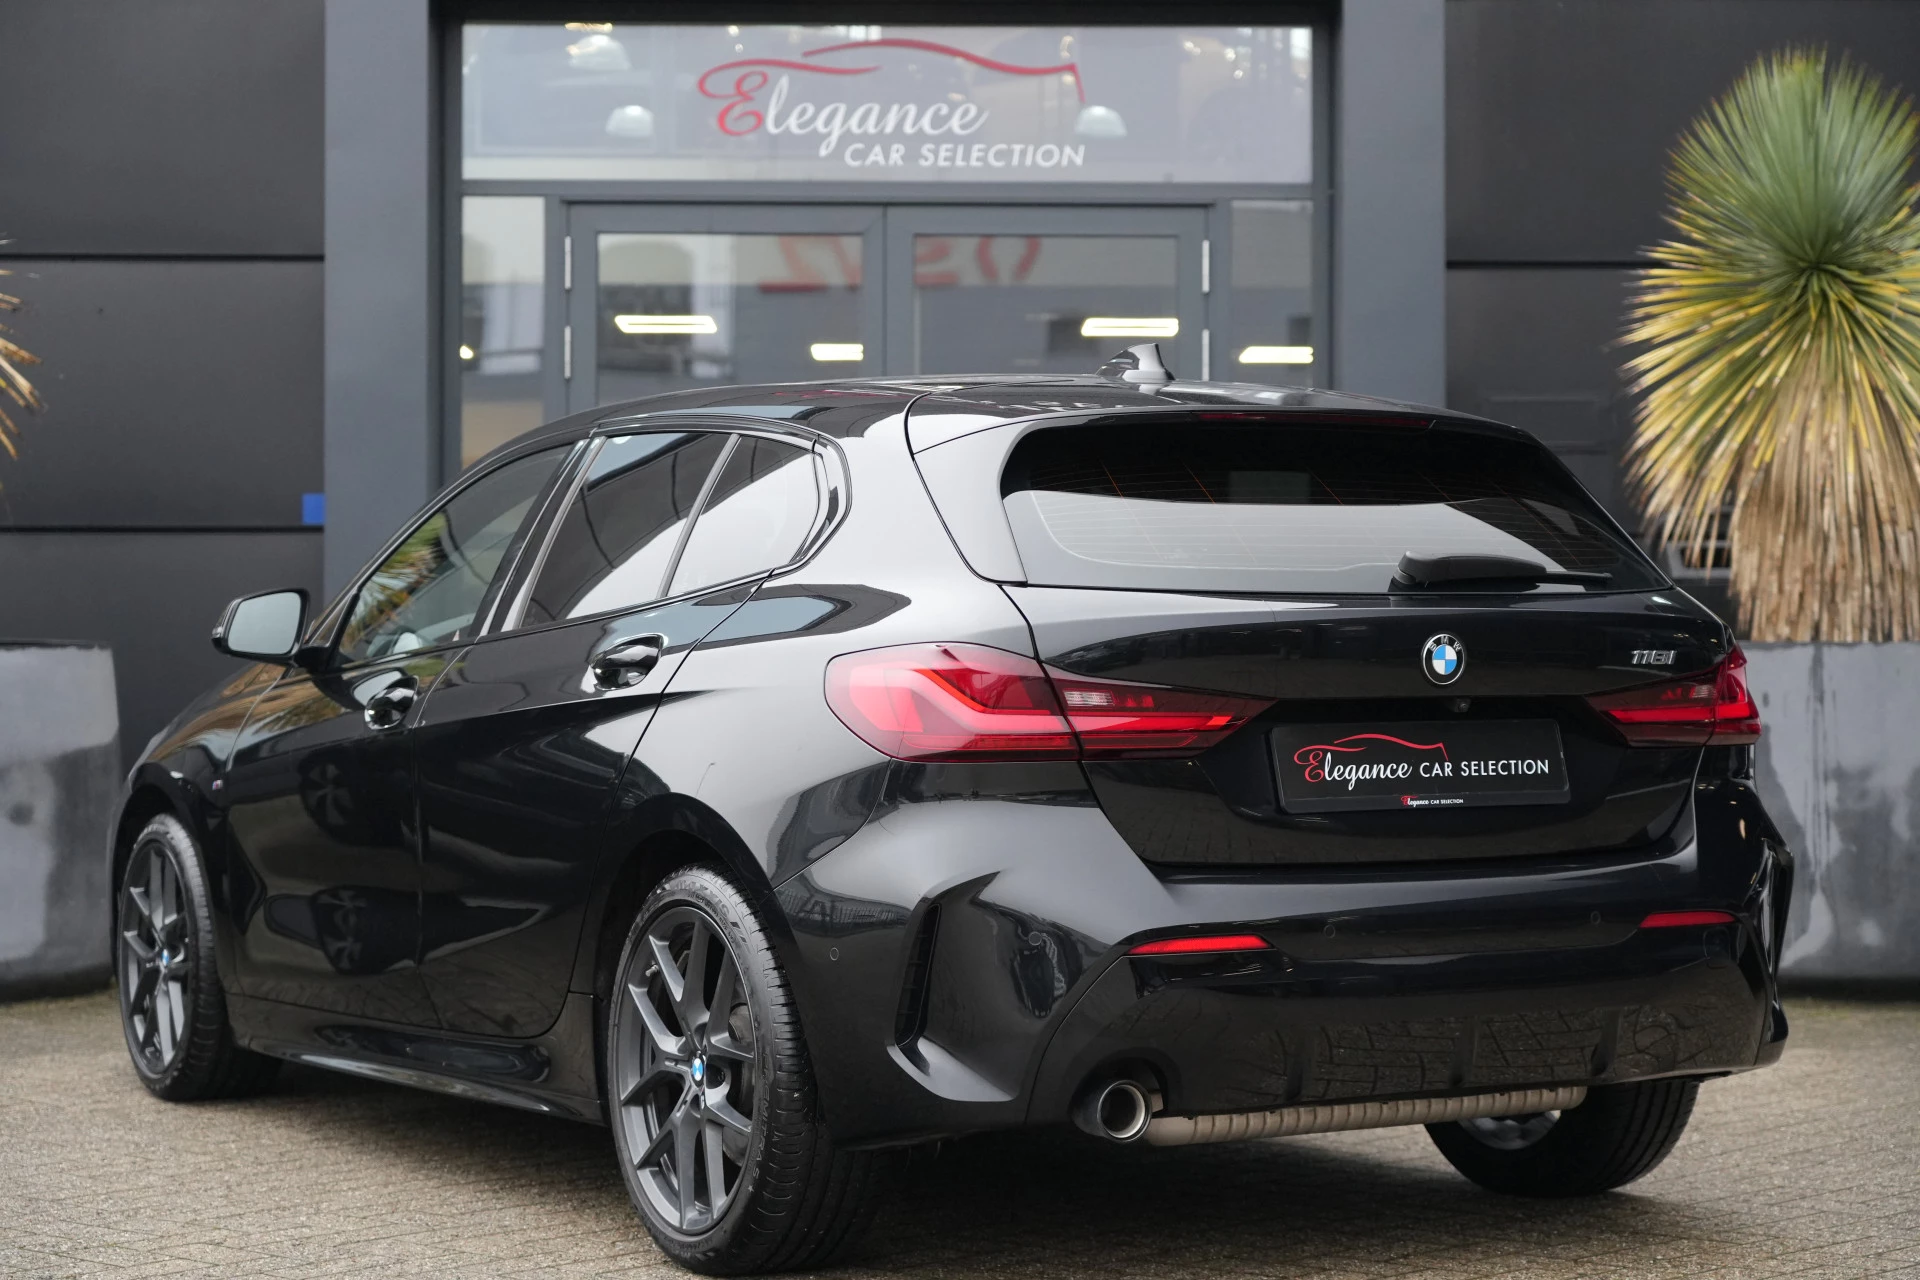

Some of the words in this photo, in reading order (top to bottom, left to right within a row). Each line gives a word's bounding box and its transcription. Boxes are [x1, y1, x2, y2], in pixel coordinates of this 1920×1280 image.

[698, 60, 989, 157] Elegance
[844, 142, 906, 168] CAR
[918, 142, 1086, 168] SELECTION
[1294, 746, 1412, 790] Elegance
[1419, 761, 1454, 777] CAR
[1460, 759, 1549, 776] SELECTION
